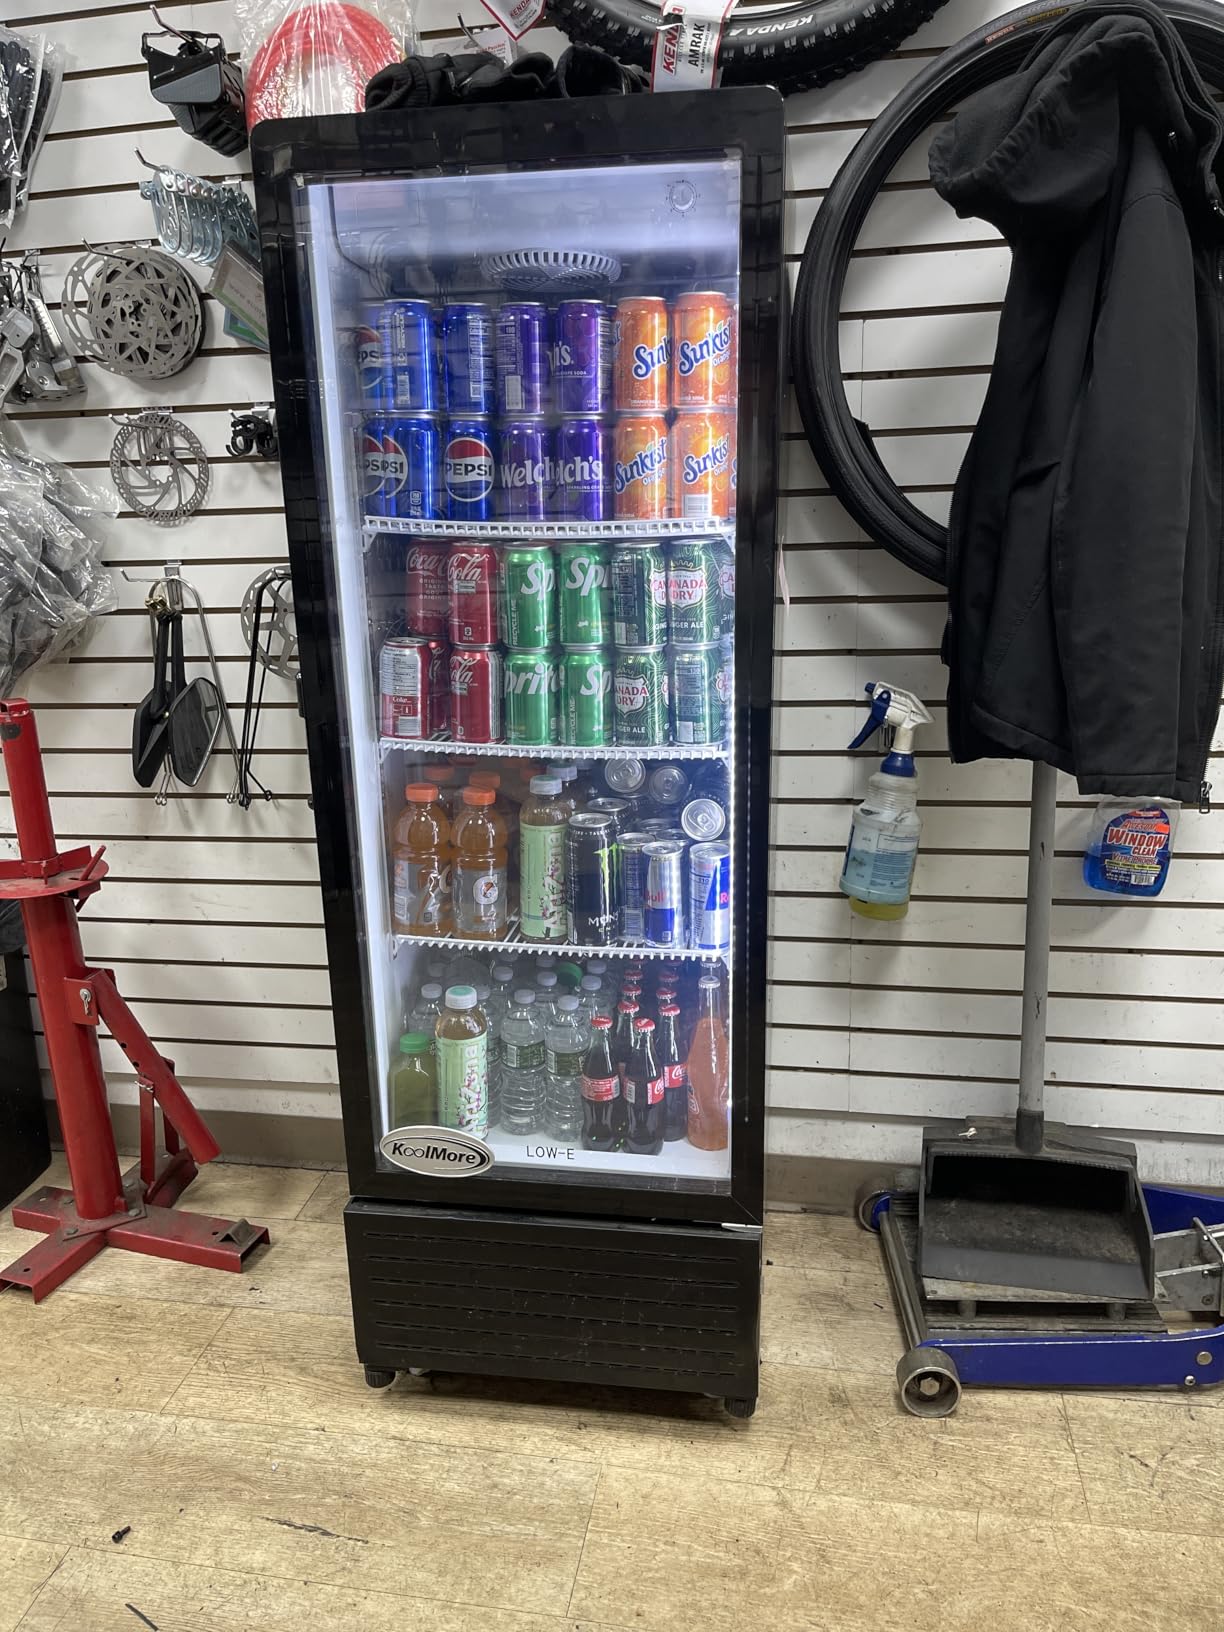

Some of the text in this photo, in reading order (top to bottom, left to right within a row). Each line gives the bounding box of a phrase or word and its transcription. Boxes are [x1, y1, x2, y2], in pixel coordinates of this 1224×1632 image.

[746, 14, 814, 36] KENDA
[688, 23, 706, 68] AMRAK
[445, 462, 493, 477] PEPSI
[615, 437, 667, 494] Sunkist
[672, 590, 694, 600] DRY
[690, 620, 705, 629] ALE
[632, 726, 646, 734] ALE
[1107, 828, 1168, 850] WINDOW
[1131, 846, 1158, 857] CLEAN
[392, 1142, 476, 1164] KoolMore
[526, 1145, 575, 1160] LOW-E
